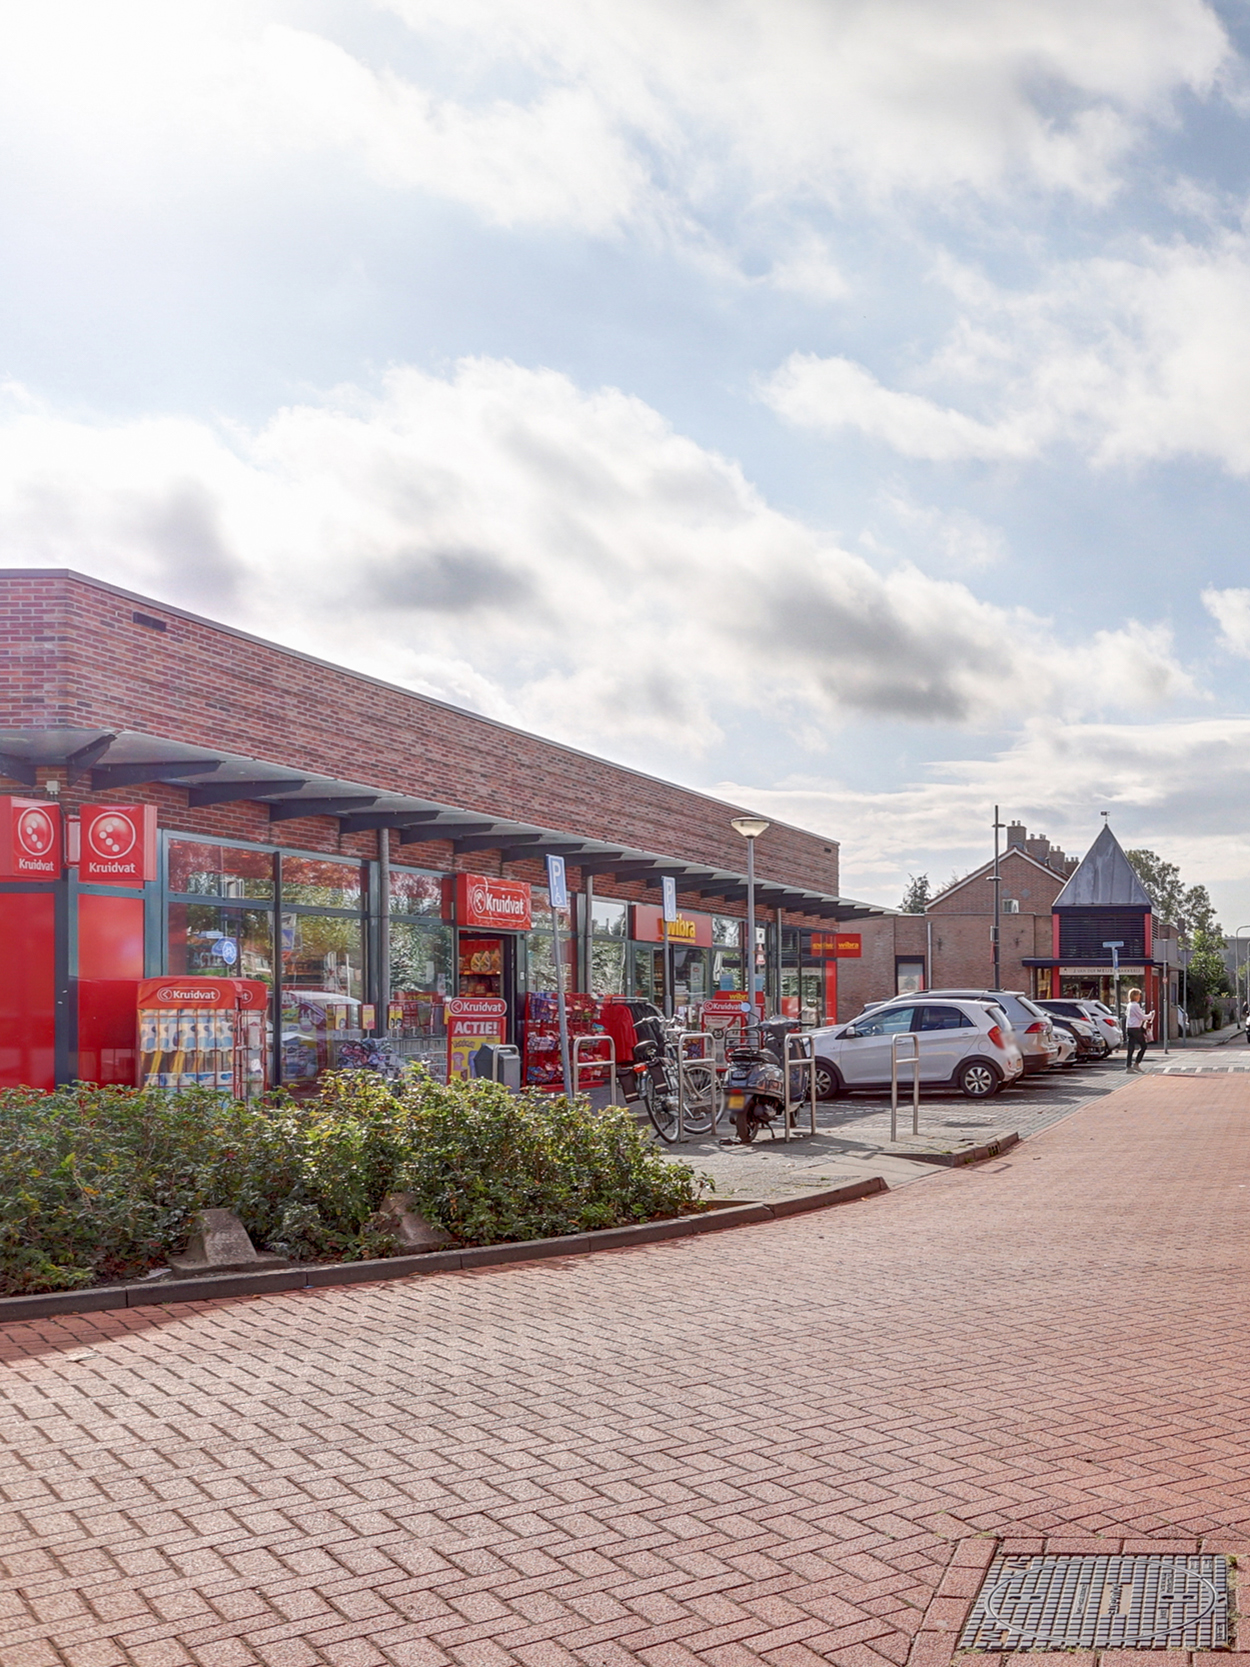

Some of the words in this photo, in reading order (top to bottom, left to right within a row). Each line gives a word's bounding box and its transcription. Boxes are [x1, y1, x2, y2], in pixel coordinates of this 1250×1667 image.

[18, 858, 54, 871] Kruidvat
[89, 862, 136, 873] Kruidvat
[552, 860, 561, 886] P
[666, 881, 673, 904] P
[486, 892, 525, 915] Kruidvat
[838, 941, 860, 949] wibra
[173, 990, 215, 999] Kruidvat
[463, 1002, 502, 1012] Kruidvat
[454, 1021, 498, 1034] ACTIE!
